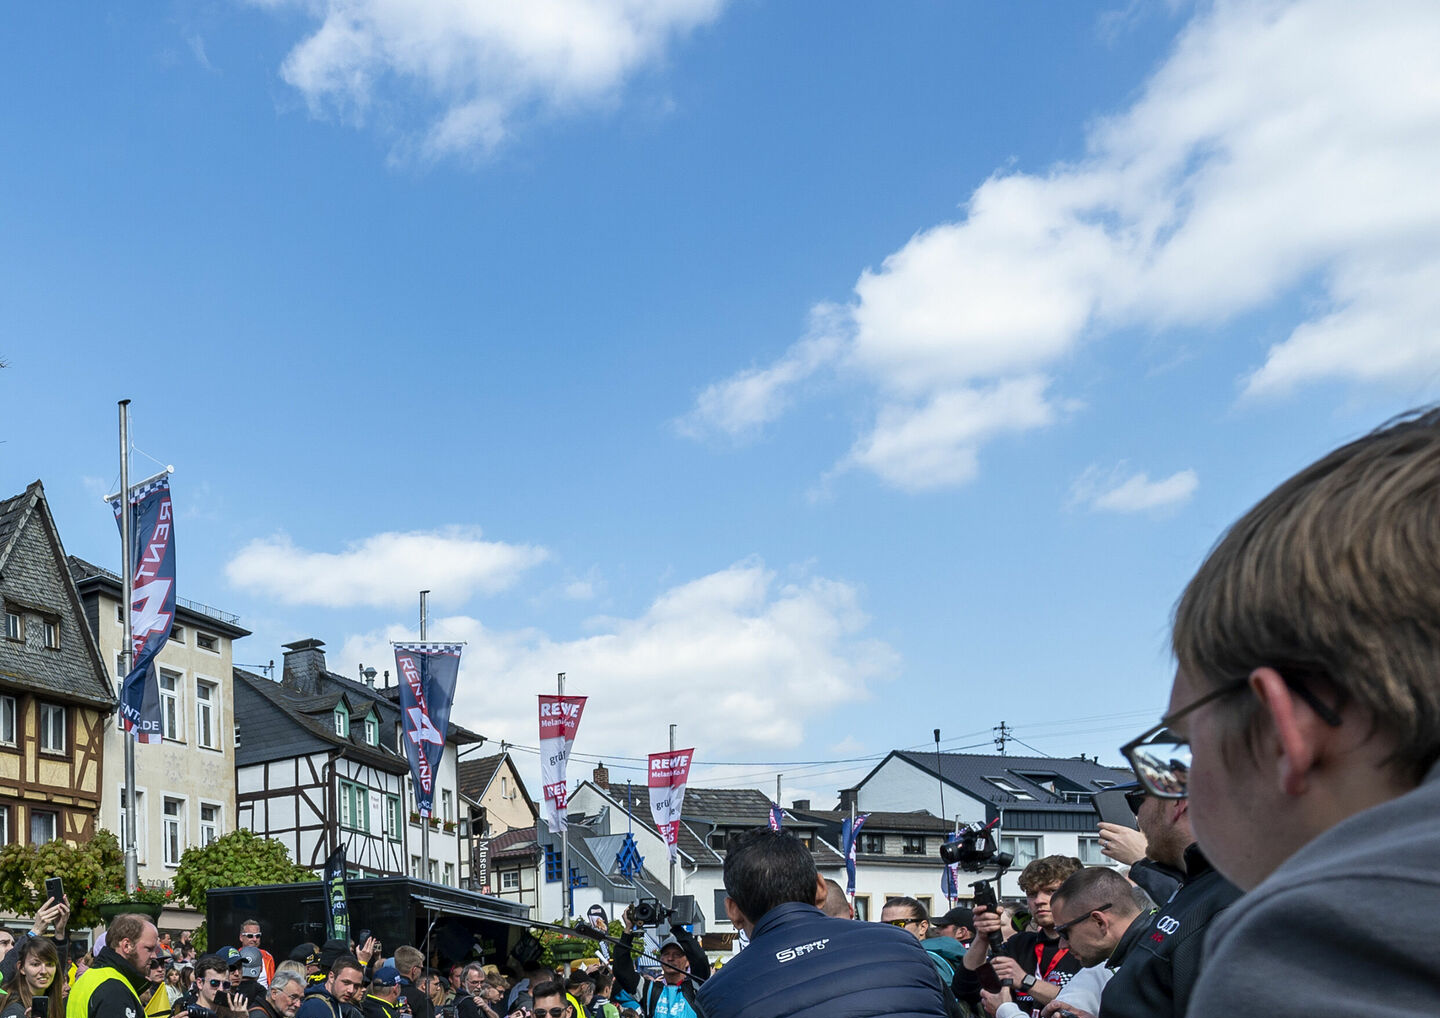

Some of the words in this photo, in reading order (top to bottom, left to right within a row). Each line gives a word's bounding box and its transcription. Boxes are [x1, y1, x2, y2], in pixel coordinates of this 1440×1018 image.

[399, 657, 426, 709] RENT
[408, 708, 443, 745] 4
[541, 703, 580, 718] REWE
[651, 756, 688, 770] REWE
[479, 841, 489, 885] Museum
